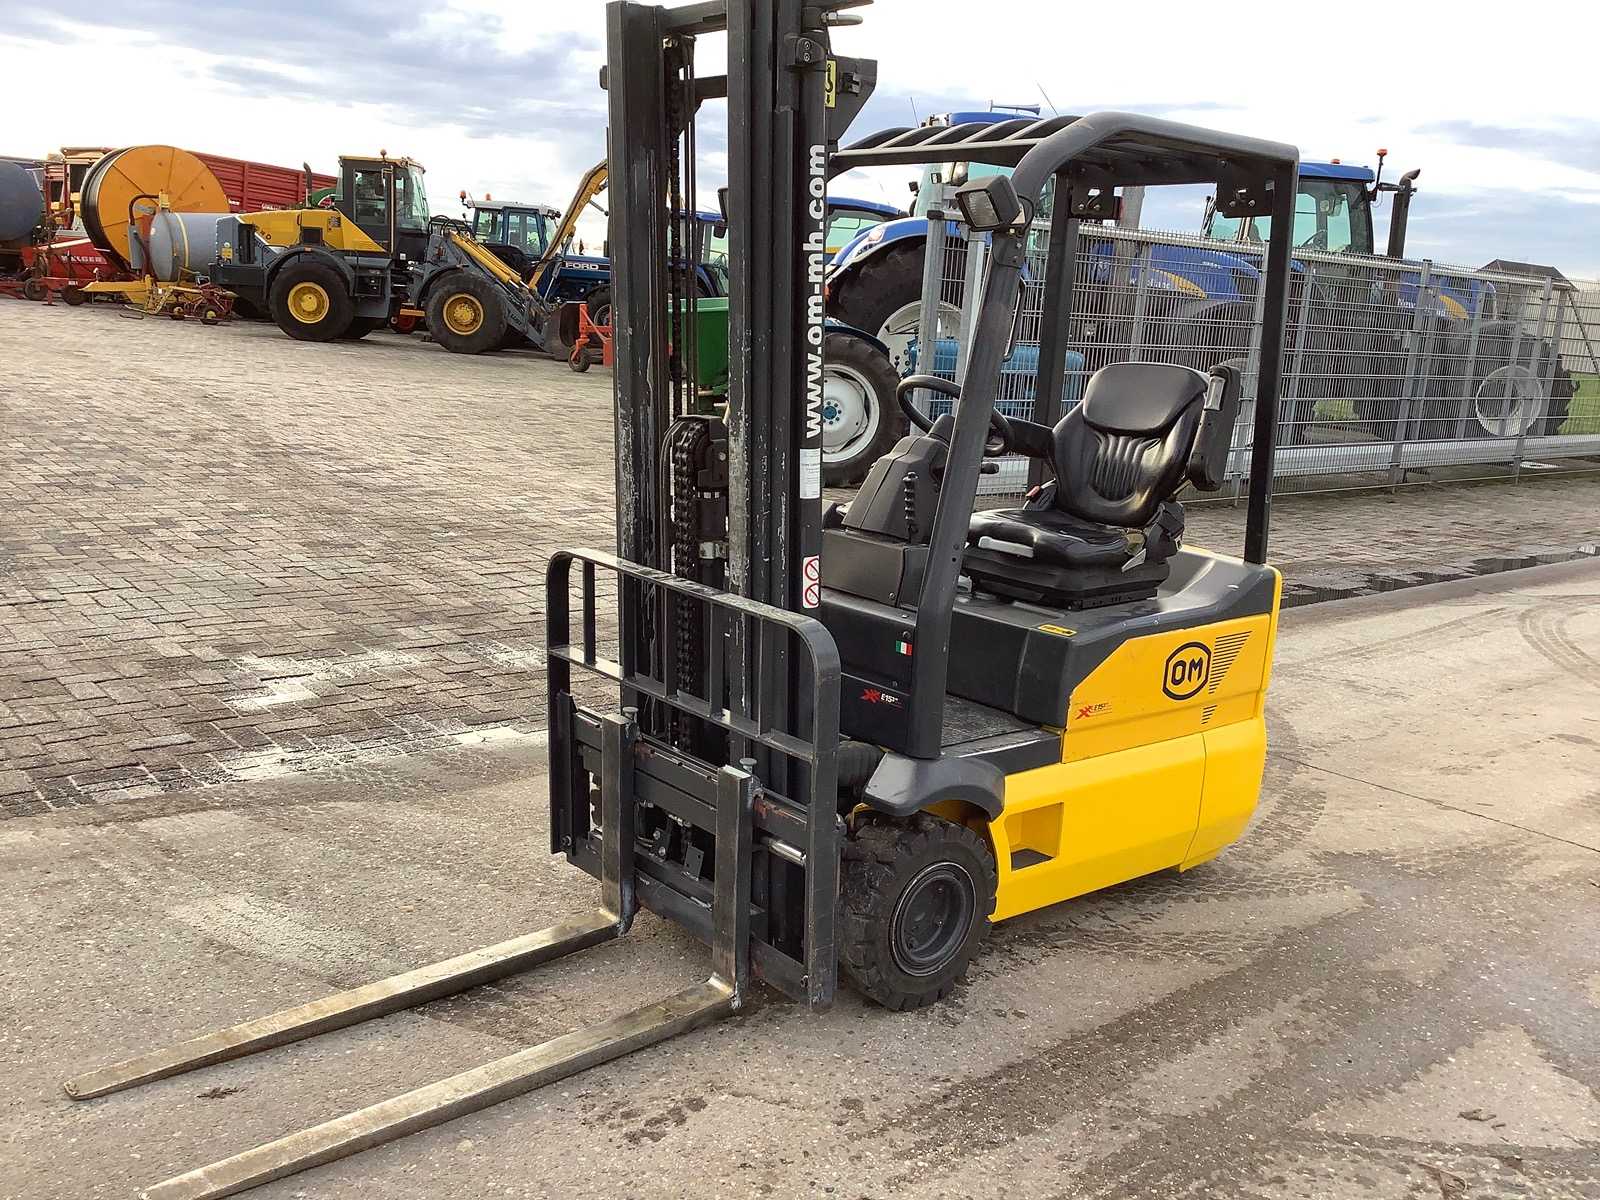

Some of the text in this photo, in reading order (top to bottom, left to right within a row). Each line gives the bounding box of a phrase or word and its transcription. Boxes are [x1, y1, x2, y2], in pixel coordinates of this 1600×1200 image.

[565, 261, 599, 270] FORD
[803, 144, 825, 439] www.om-mh.com
[1171, 657, 1203, 686] OM
